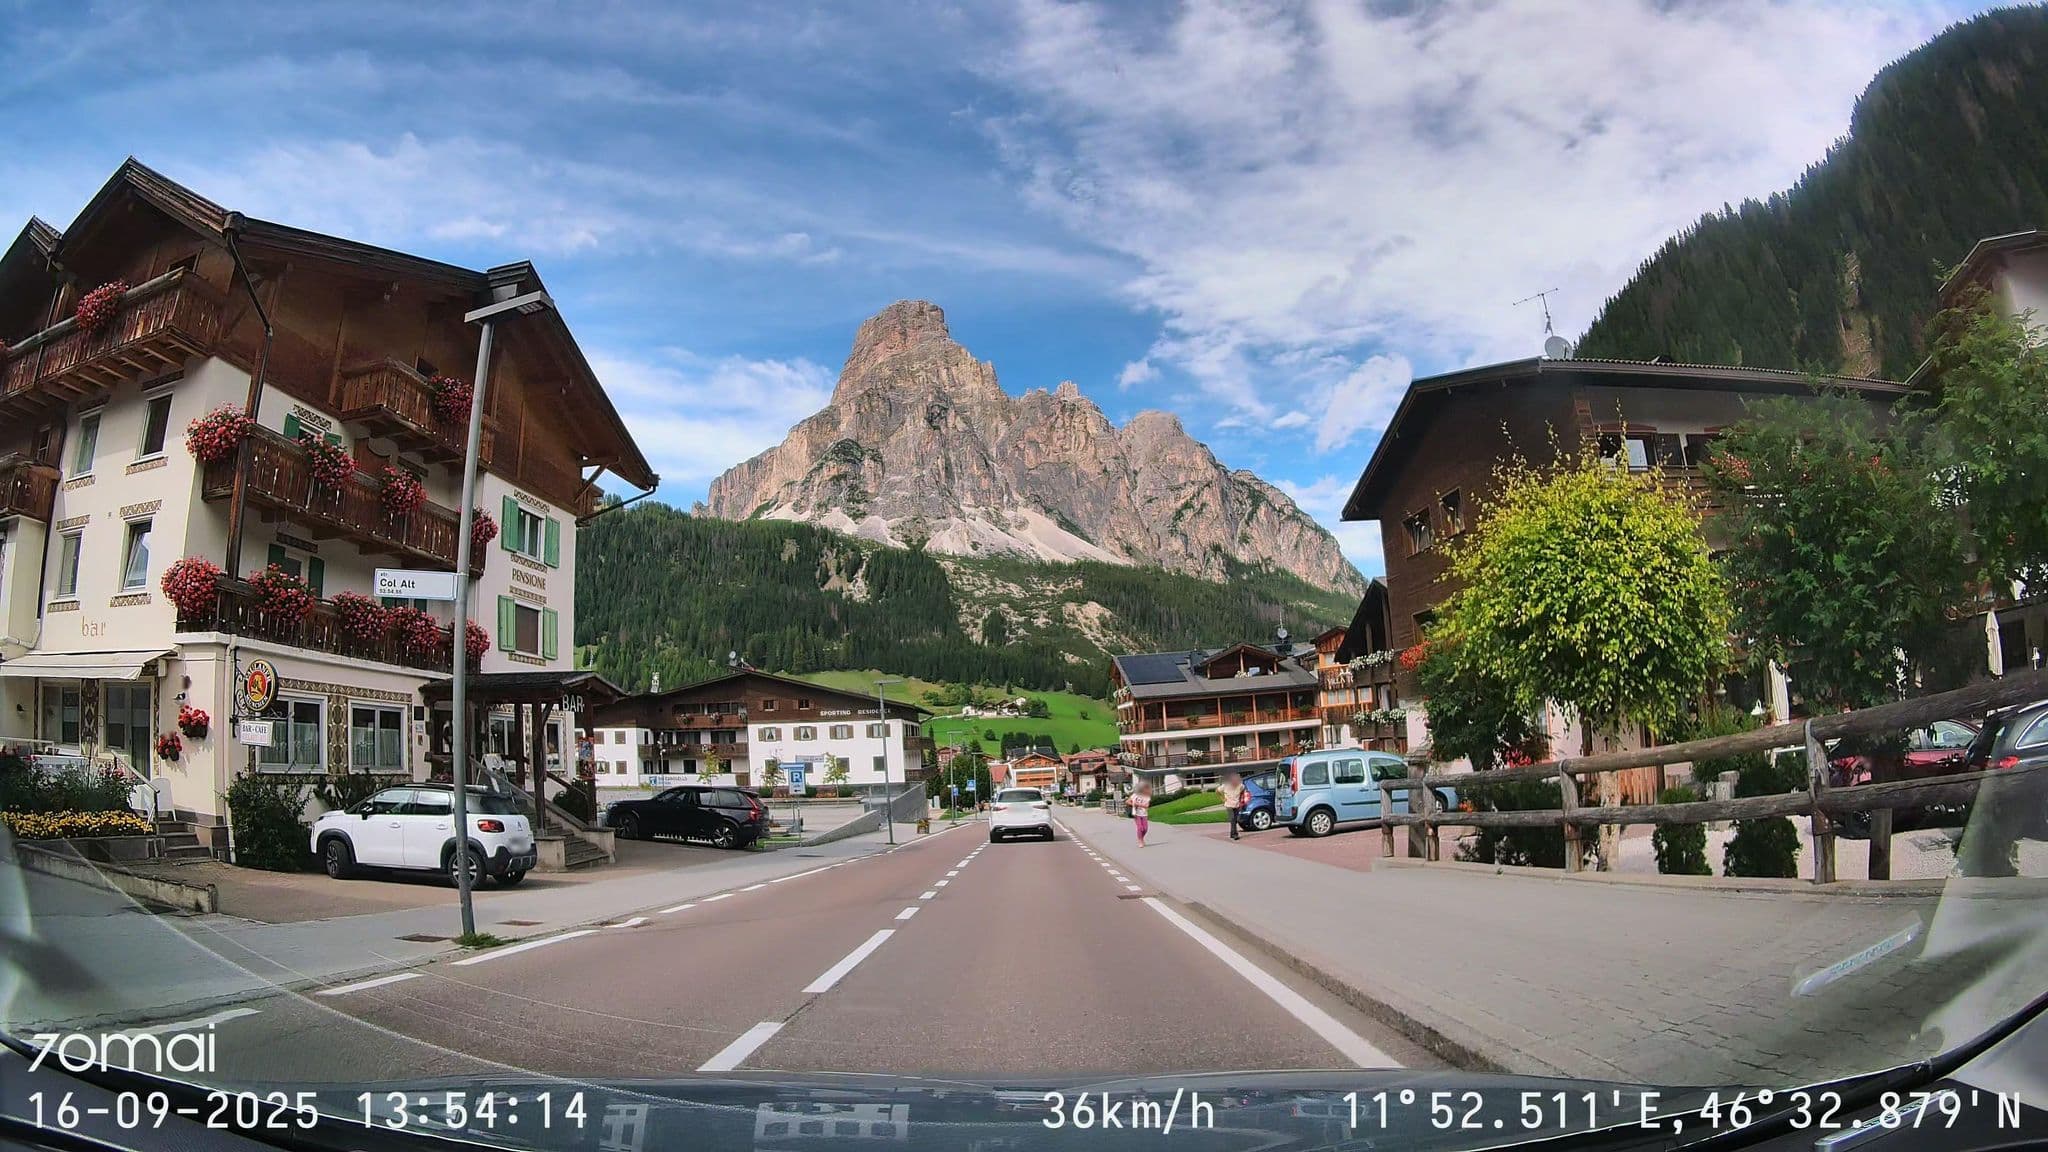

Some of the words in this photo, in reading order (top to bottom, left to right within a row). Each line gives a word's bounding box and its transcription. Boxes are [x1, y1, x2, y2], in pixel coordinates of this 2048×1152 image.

[380, 578, 396, 587] Col
[401, 579, 416, 589] Alt
[512, 568, 546, 591] PENSIONE
[82, 615, 106, 637] bar
[562, 694, 584, 713] BAR
[242, 724, 252, 732] BAR
